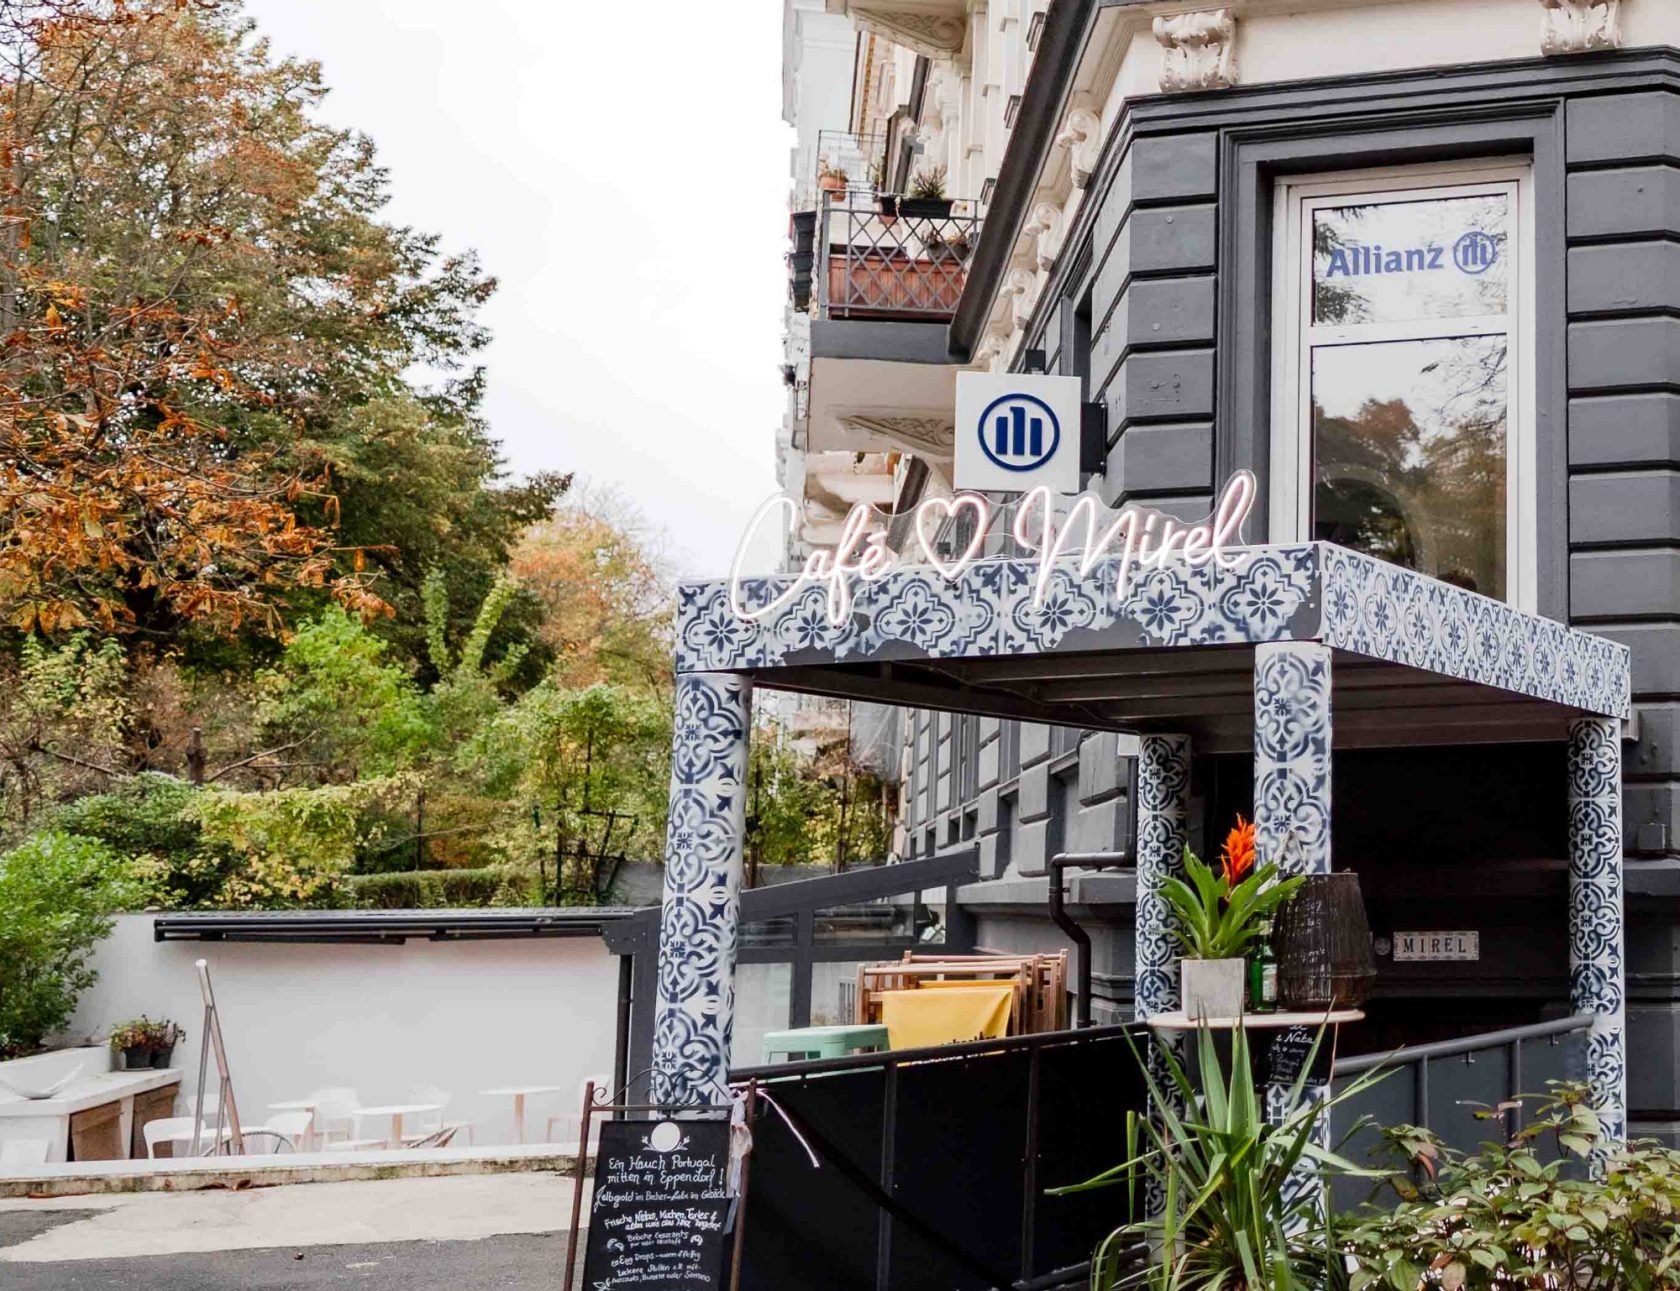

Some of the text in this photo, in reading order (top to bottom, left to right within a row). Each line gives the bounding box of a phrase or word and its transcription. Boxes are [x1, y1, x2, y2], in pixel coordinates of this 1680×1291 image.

[1326, 246, 1444, 278] Allianz
[731, 474, 1248, 626] Café Mirel
[1402, 937, 1467, 953] MIREL
[609, 1154, 716, 1173] Ein Hauch Portugal
[608, 1172, 640, 1184] mitten
[659, 1168, 716, 1190] Eppendorf
